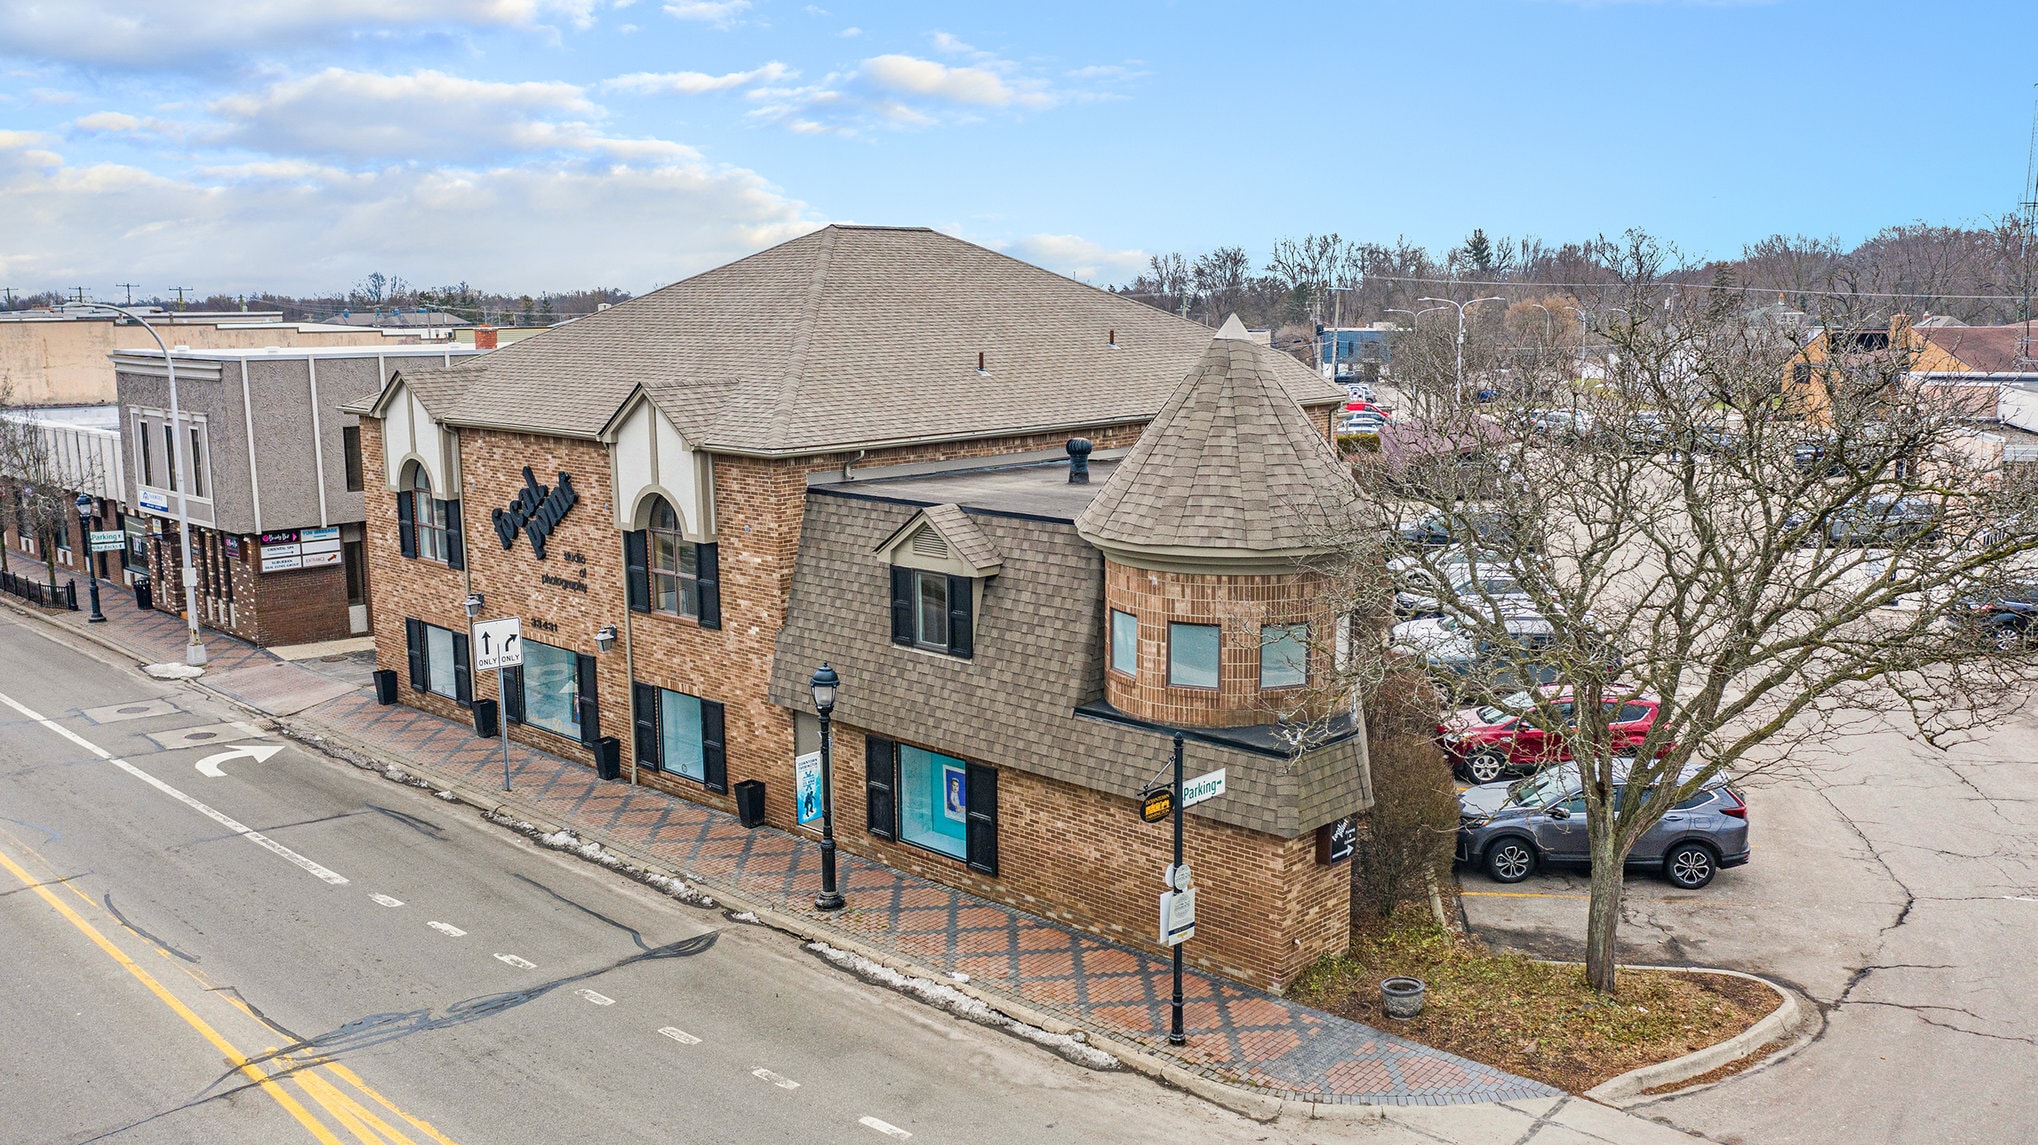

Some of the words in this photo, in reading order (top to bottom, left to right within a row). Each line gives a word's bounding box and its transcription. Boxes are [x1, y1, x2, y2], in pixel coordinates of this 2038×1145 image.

[492, 465, 549, 551] focal
[526, 471, 580, 560] point
[92, 533, 117, 542] Parking
[564, 549, 586, 564] studio
[541, 572, 588, 594] photography
[530, 617, 558, 632] 33431
[478, 657, 497, 667] ONLY
[501, 653, 520, 663] ONLY
[1183, 779, 1217, 802] Parking
